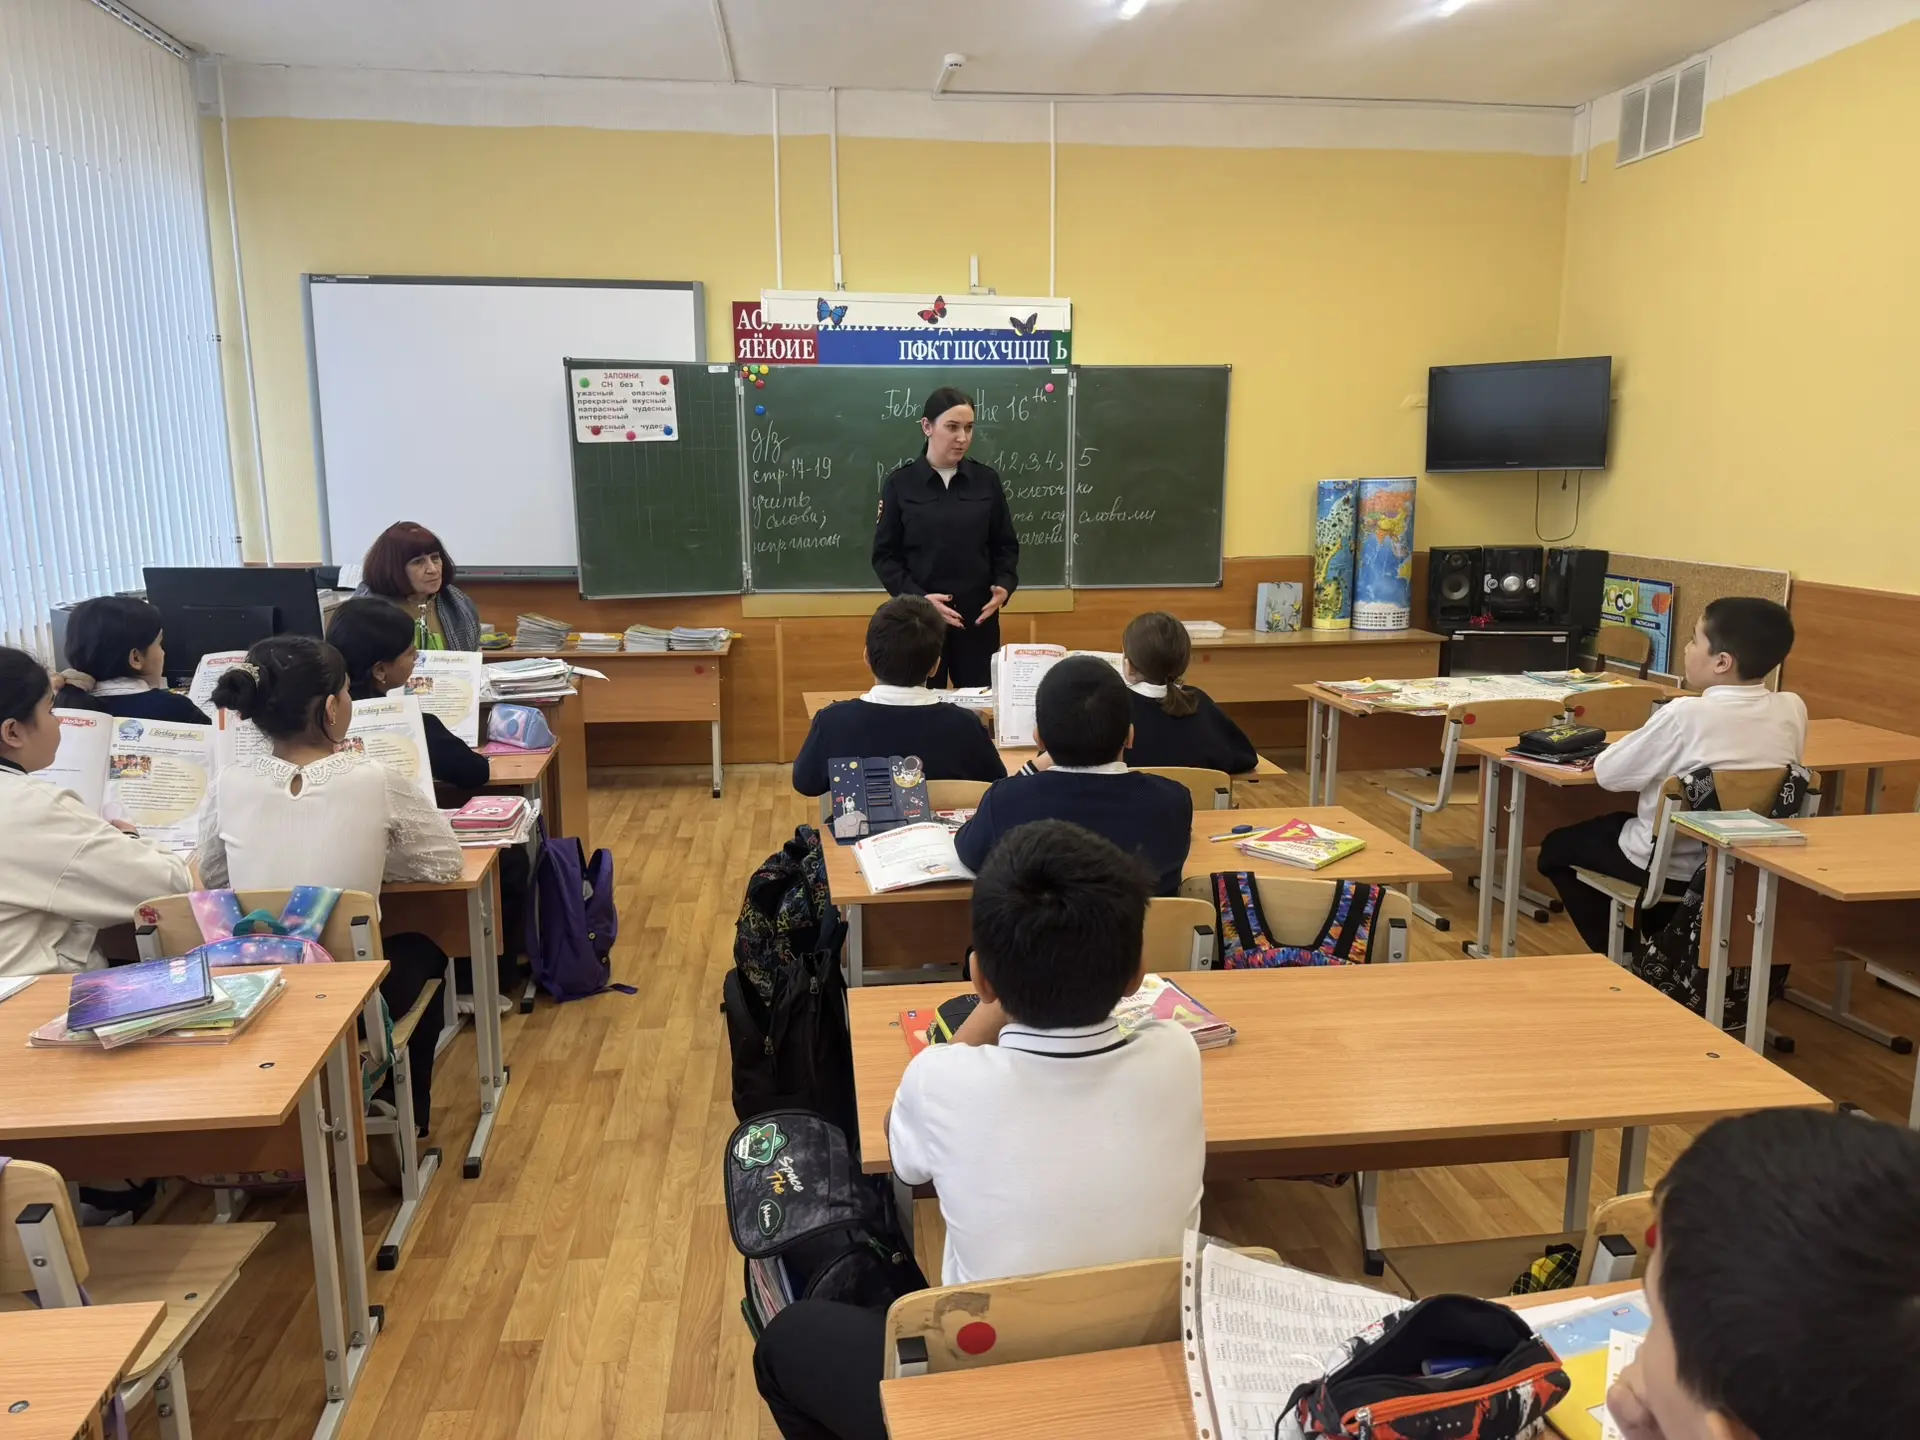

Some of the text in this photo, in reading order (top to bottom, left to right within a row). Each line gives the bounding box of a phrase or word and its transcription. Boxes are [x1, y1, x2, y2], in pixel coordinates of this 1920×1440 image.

[737, 333, 815, 359] ЯЁЮИЕ
[899, 340, 1050, 364] ПФКТШСХЧЦЩ
[577, 397, 667, 405] прекрасный вкусный
[578, 405, 625, 413] напрасный
[579, 413, 629, 421] интересный
[752, 492, 810, 530] учить
[1079, 496, 1156, 525] словами
[766, 1170, 786, 1194] The
[778, 1156, 804, 1192] Space
